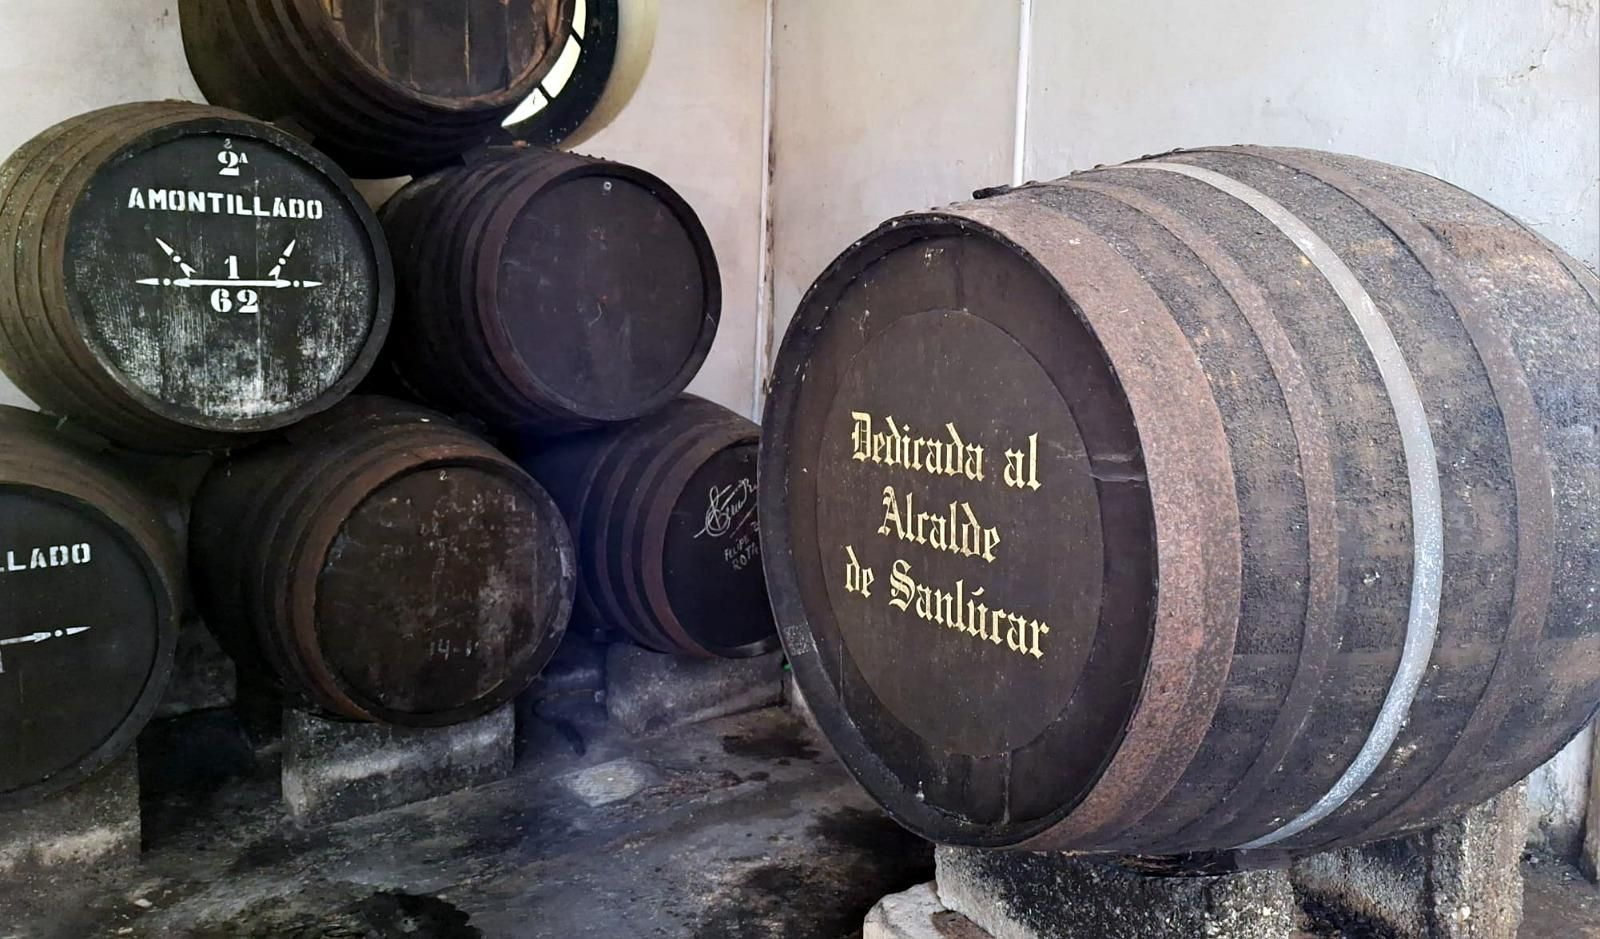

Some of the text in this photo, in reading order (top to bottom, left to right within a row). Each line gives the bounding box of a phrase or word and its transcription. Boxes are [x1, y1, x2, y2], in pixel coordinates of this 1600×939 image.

[127, 187, 324, 220] AMONTILLADO
[223, 255, 241, 280] 1
[210, 288, 259, 314] 62
[850, 410, 1042, 492] Dedicada al
[877, 484, 1001, 564] Alcalde
[0, 542, 92, 573] LADO
[844, 544, 1051, 660] de Sanlúcar
